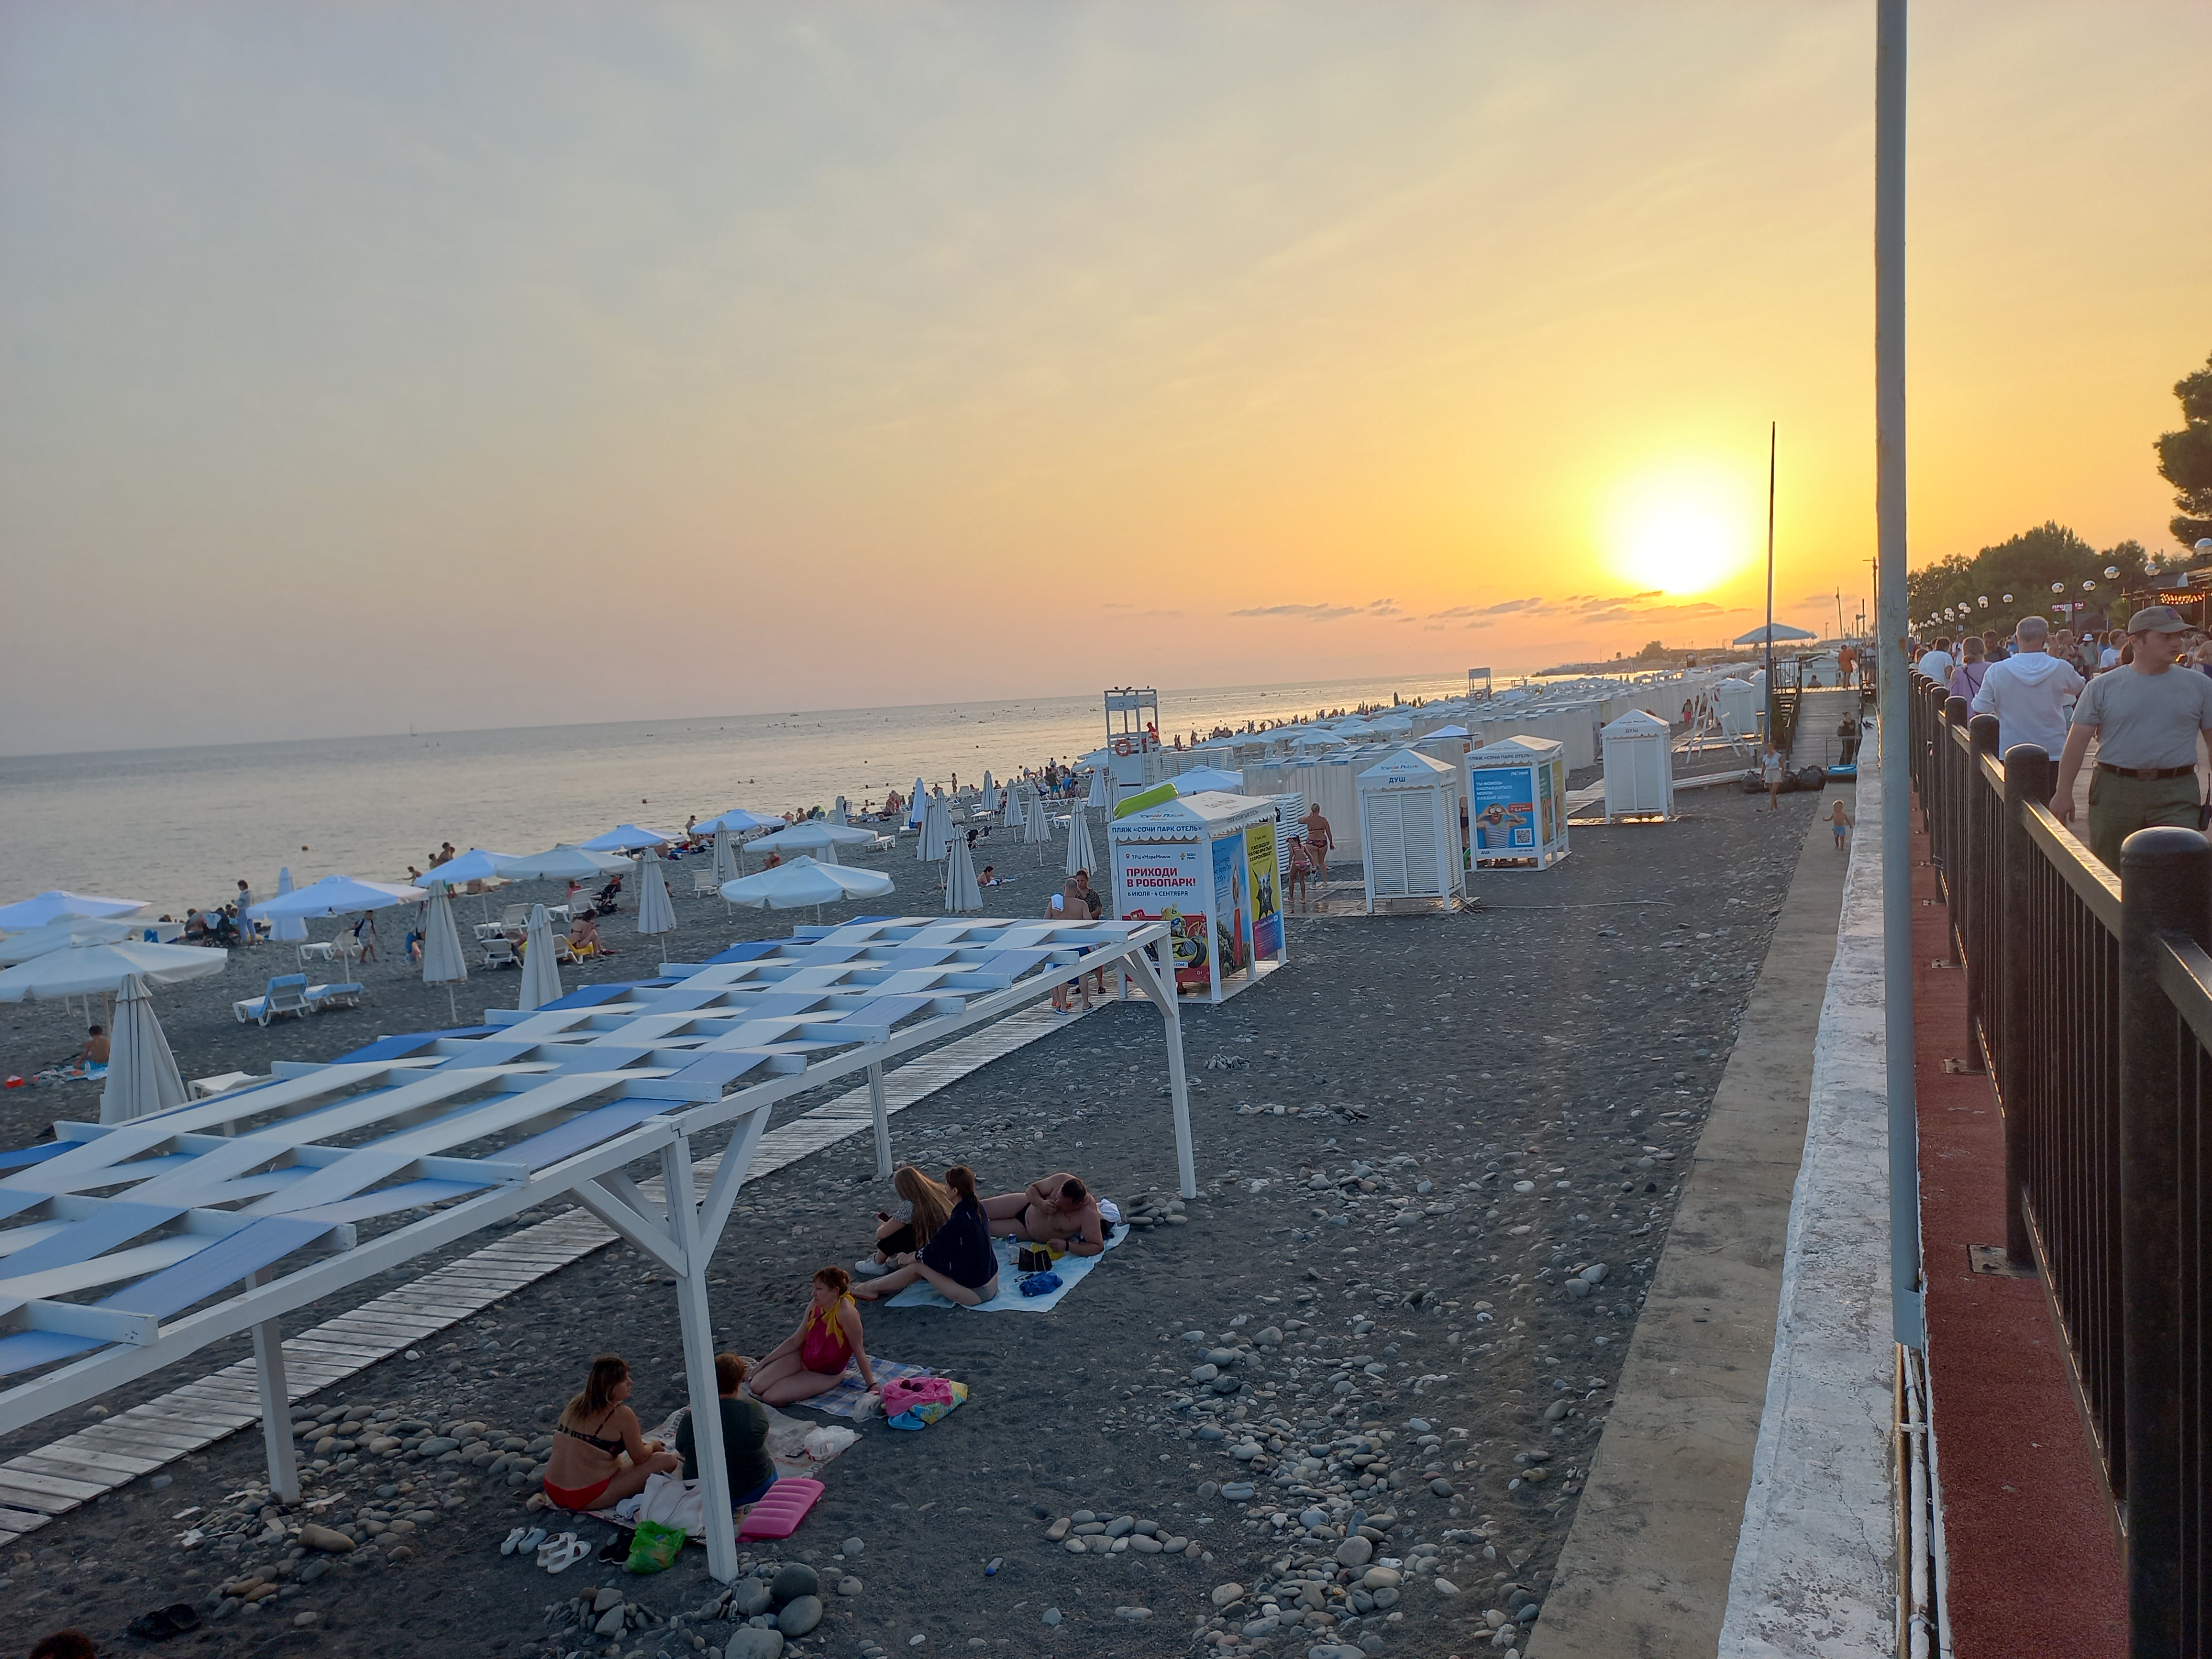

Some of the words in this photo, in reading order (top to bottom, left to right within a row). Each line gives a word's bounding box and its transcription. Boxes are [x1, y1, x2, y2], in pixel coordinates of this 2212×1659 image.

[1126, 867, 1178, 878] ПРИХОДИ
[1127, 879, 1134, 887] В
[1136, 878, 1196, 887] РОБОПАРК!
